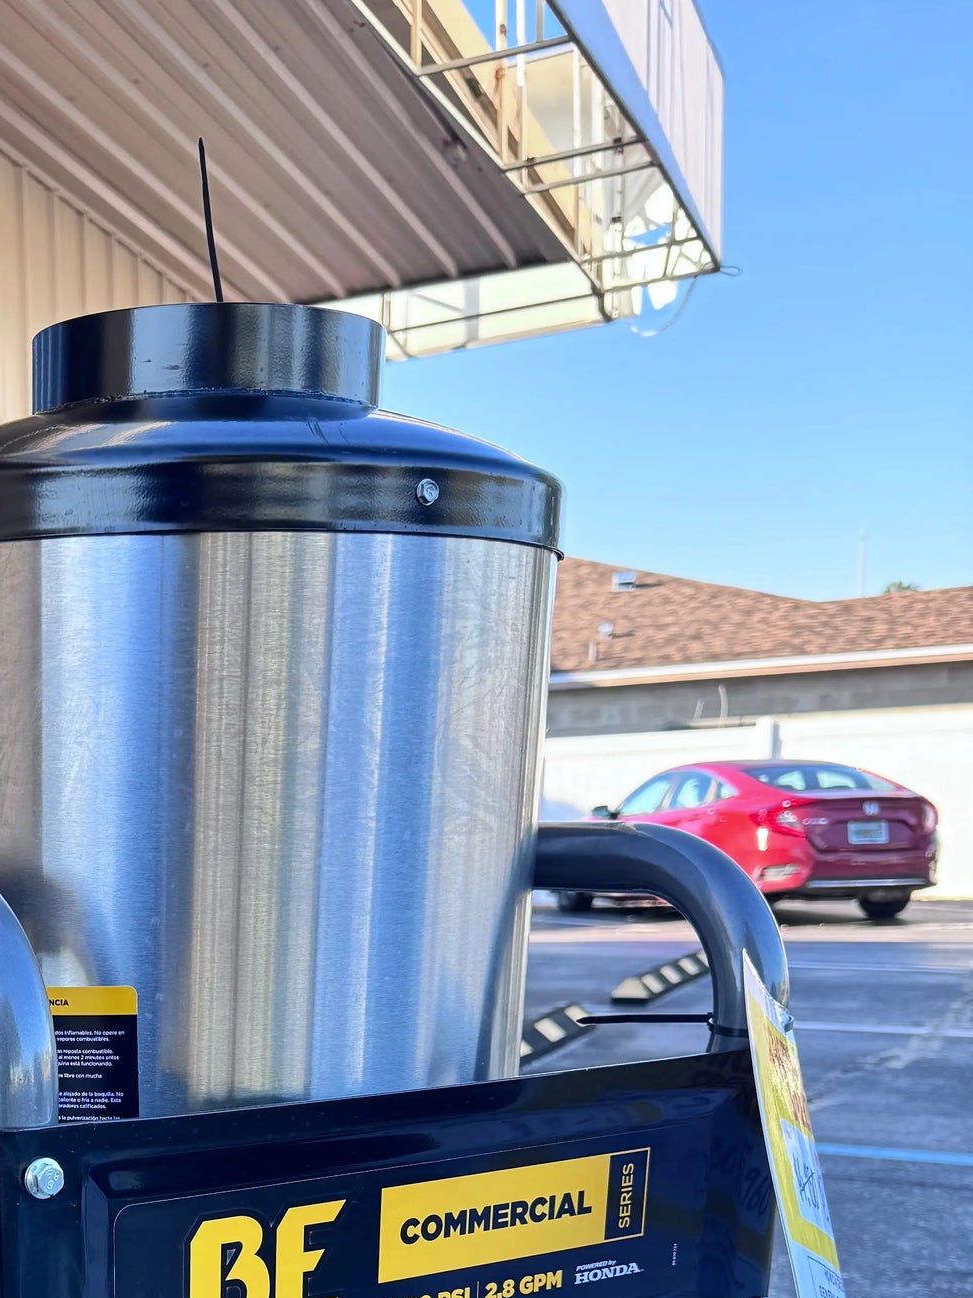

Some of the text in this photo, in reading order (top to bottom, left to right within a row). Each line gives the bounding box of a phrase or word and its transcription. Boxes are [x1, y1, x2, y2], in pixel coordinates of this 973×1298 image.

[618, 1162, 635, 1229] SERIES
[400, 1190, 592, 1245] COMMERCIAL
[574, 1262, 641, 1285] HONDA
[575, 1259, 617, 1272] POWERED by
[518, 1270, 563, 1294] GPM
